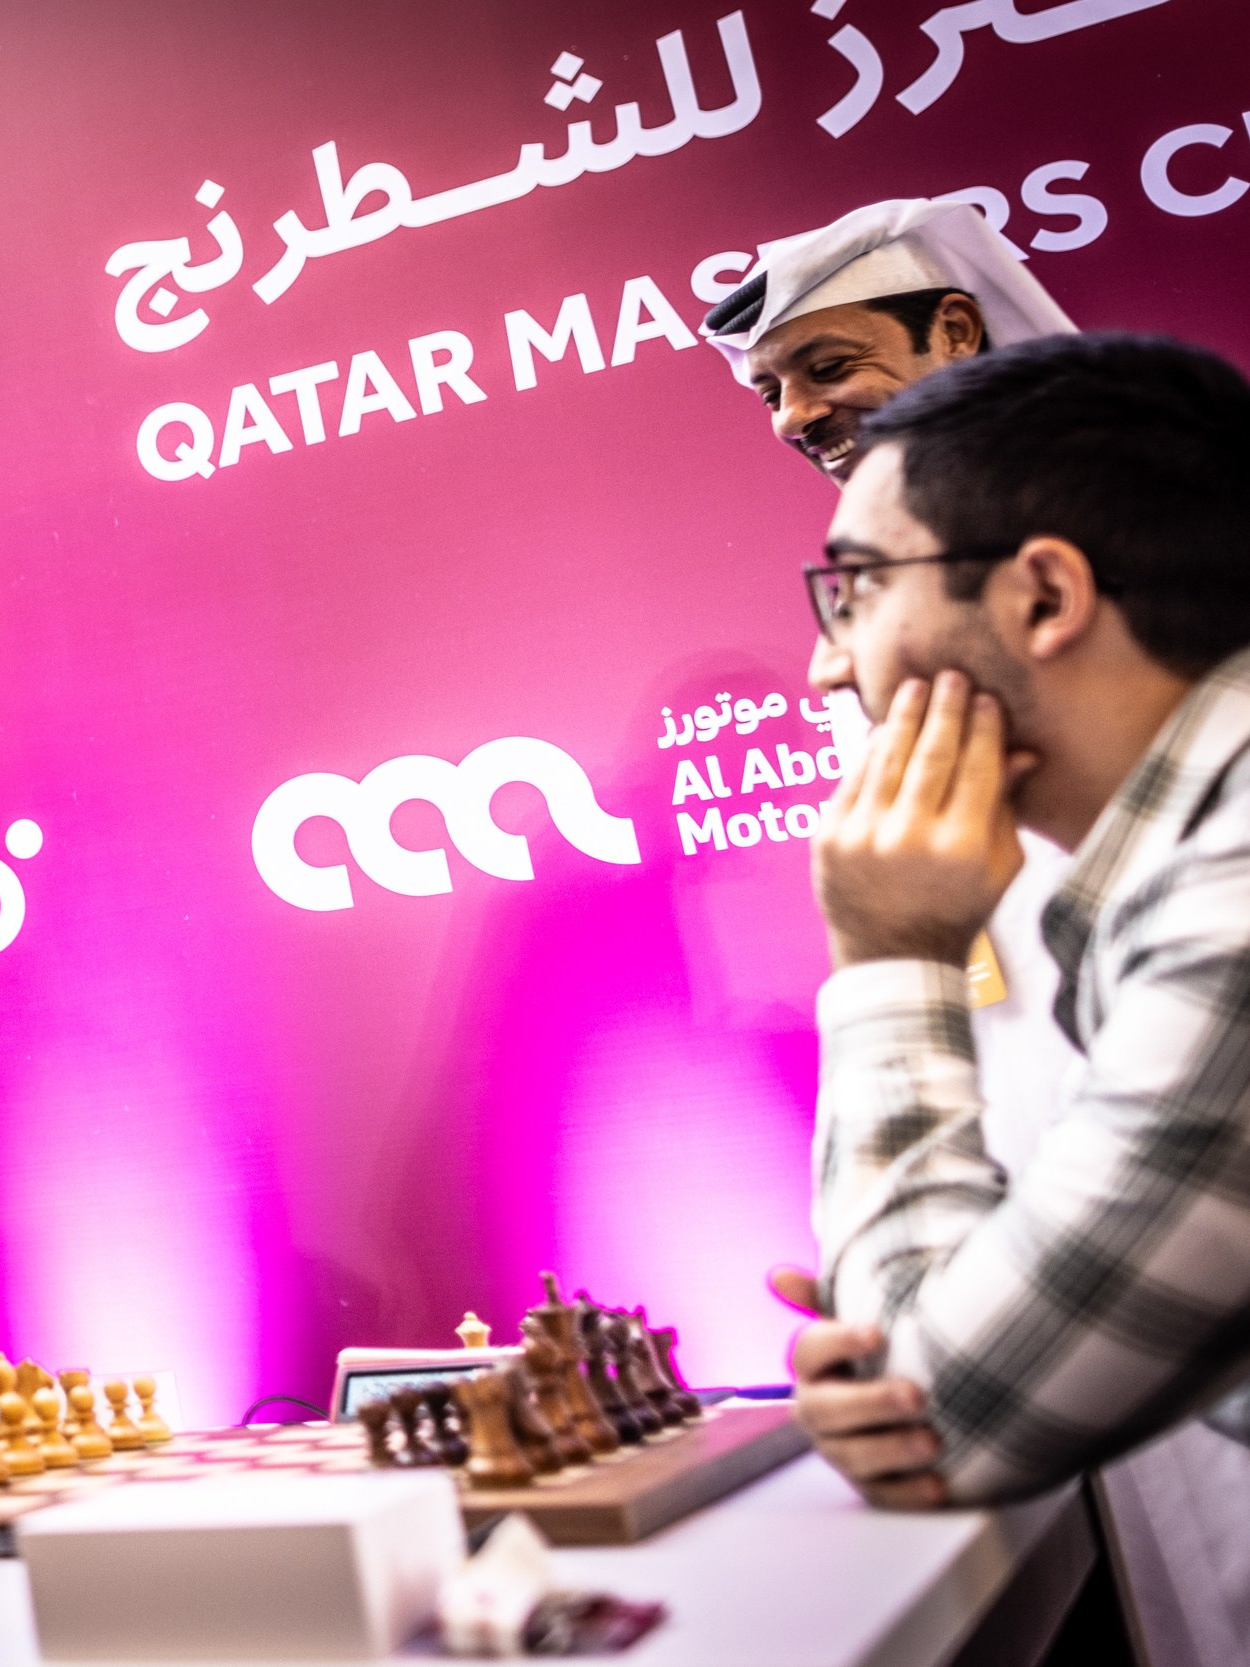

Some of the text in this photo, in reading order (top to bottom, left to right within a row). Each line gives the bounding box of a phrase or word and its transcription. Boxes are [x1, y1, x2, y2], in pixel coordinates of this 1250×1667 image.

[136, 329, 488, 482] QATAR
[1140, 111, 1250, 217] C
[657, 691, 789, 749] موتورز
[671, 755, 733, 806] Al
